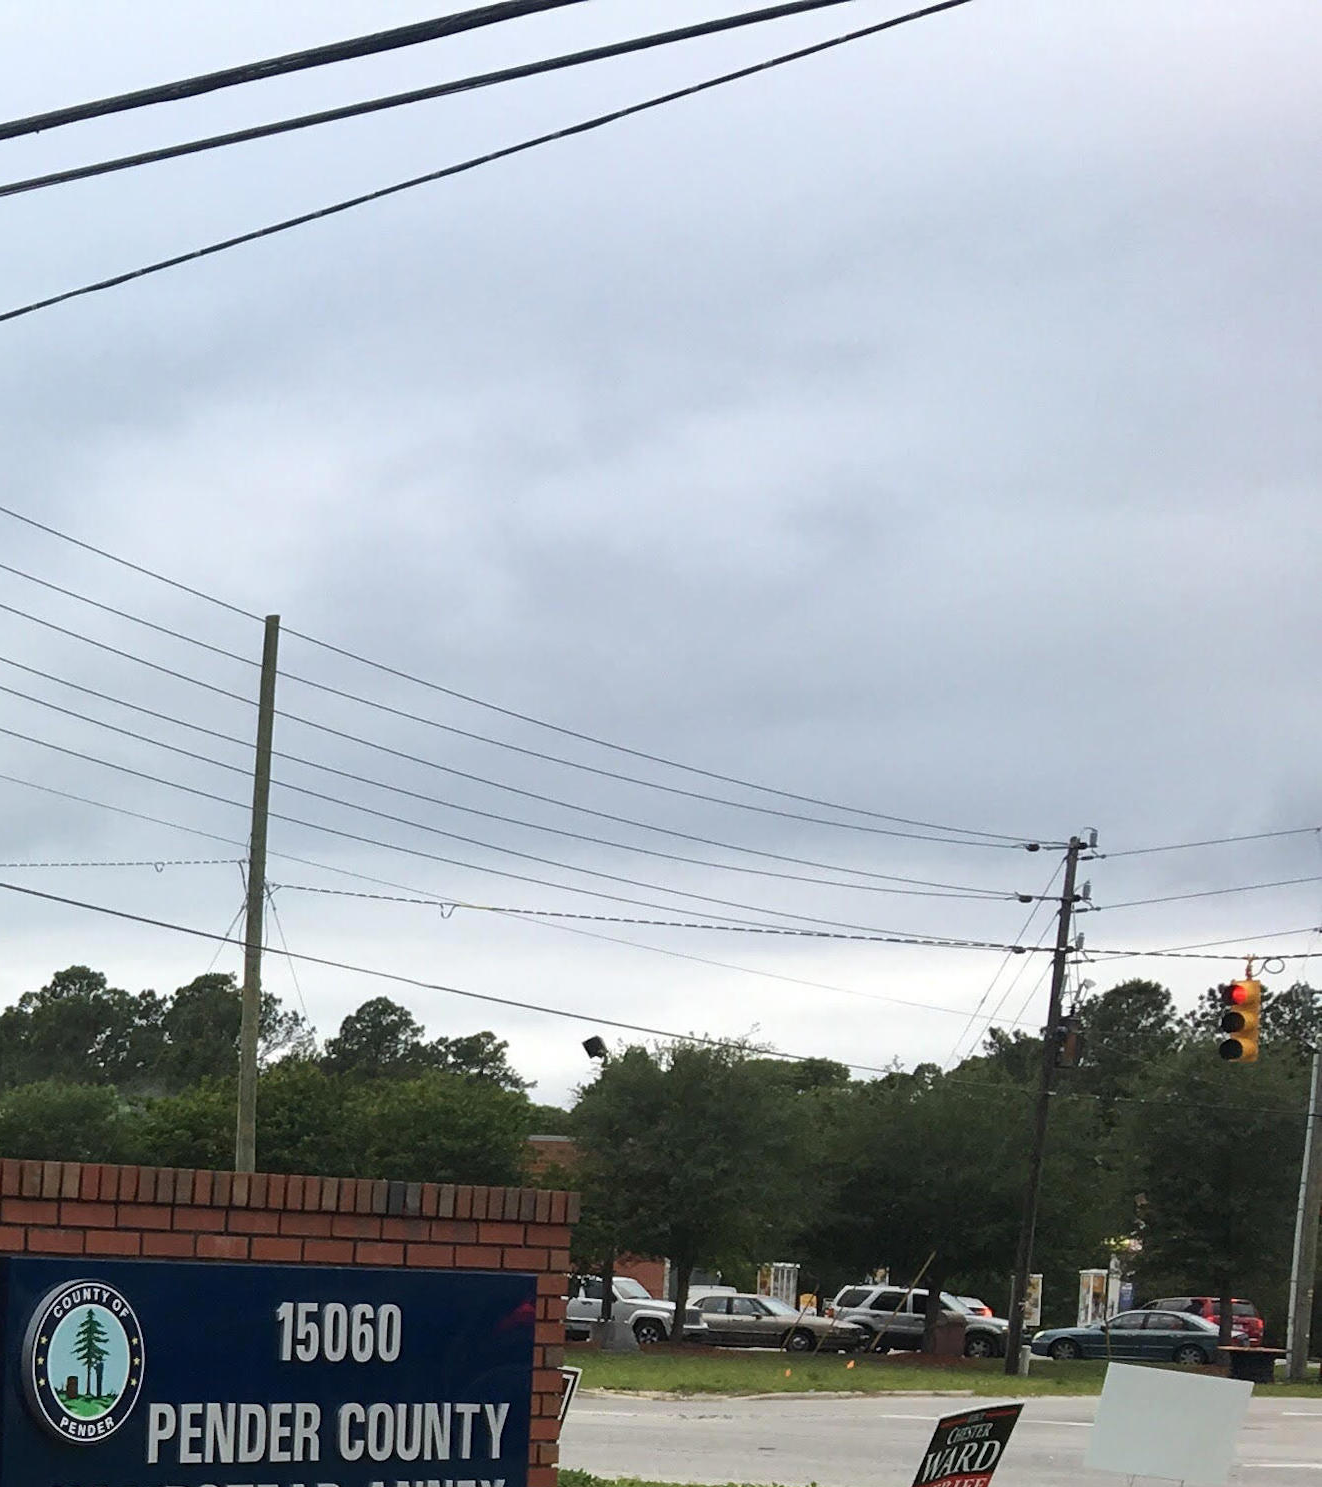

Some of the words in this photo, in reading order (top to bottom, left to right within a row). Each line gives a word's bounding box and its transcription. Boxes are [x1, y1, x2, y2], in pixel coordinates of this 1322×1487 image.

[53, 1288, 110, 1319] COUNTY
[111, 1298, 130, 1318] OF
[276, 1301, 402, 1363] 15060
[59, 1416, 115, 1437] PENDER
[147, 1402, 322, 1465] PENDER
[337, 1402, 510, 1462] COUNTY
[922, 1440, 1001, 1482] WARD
